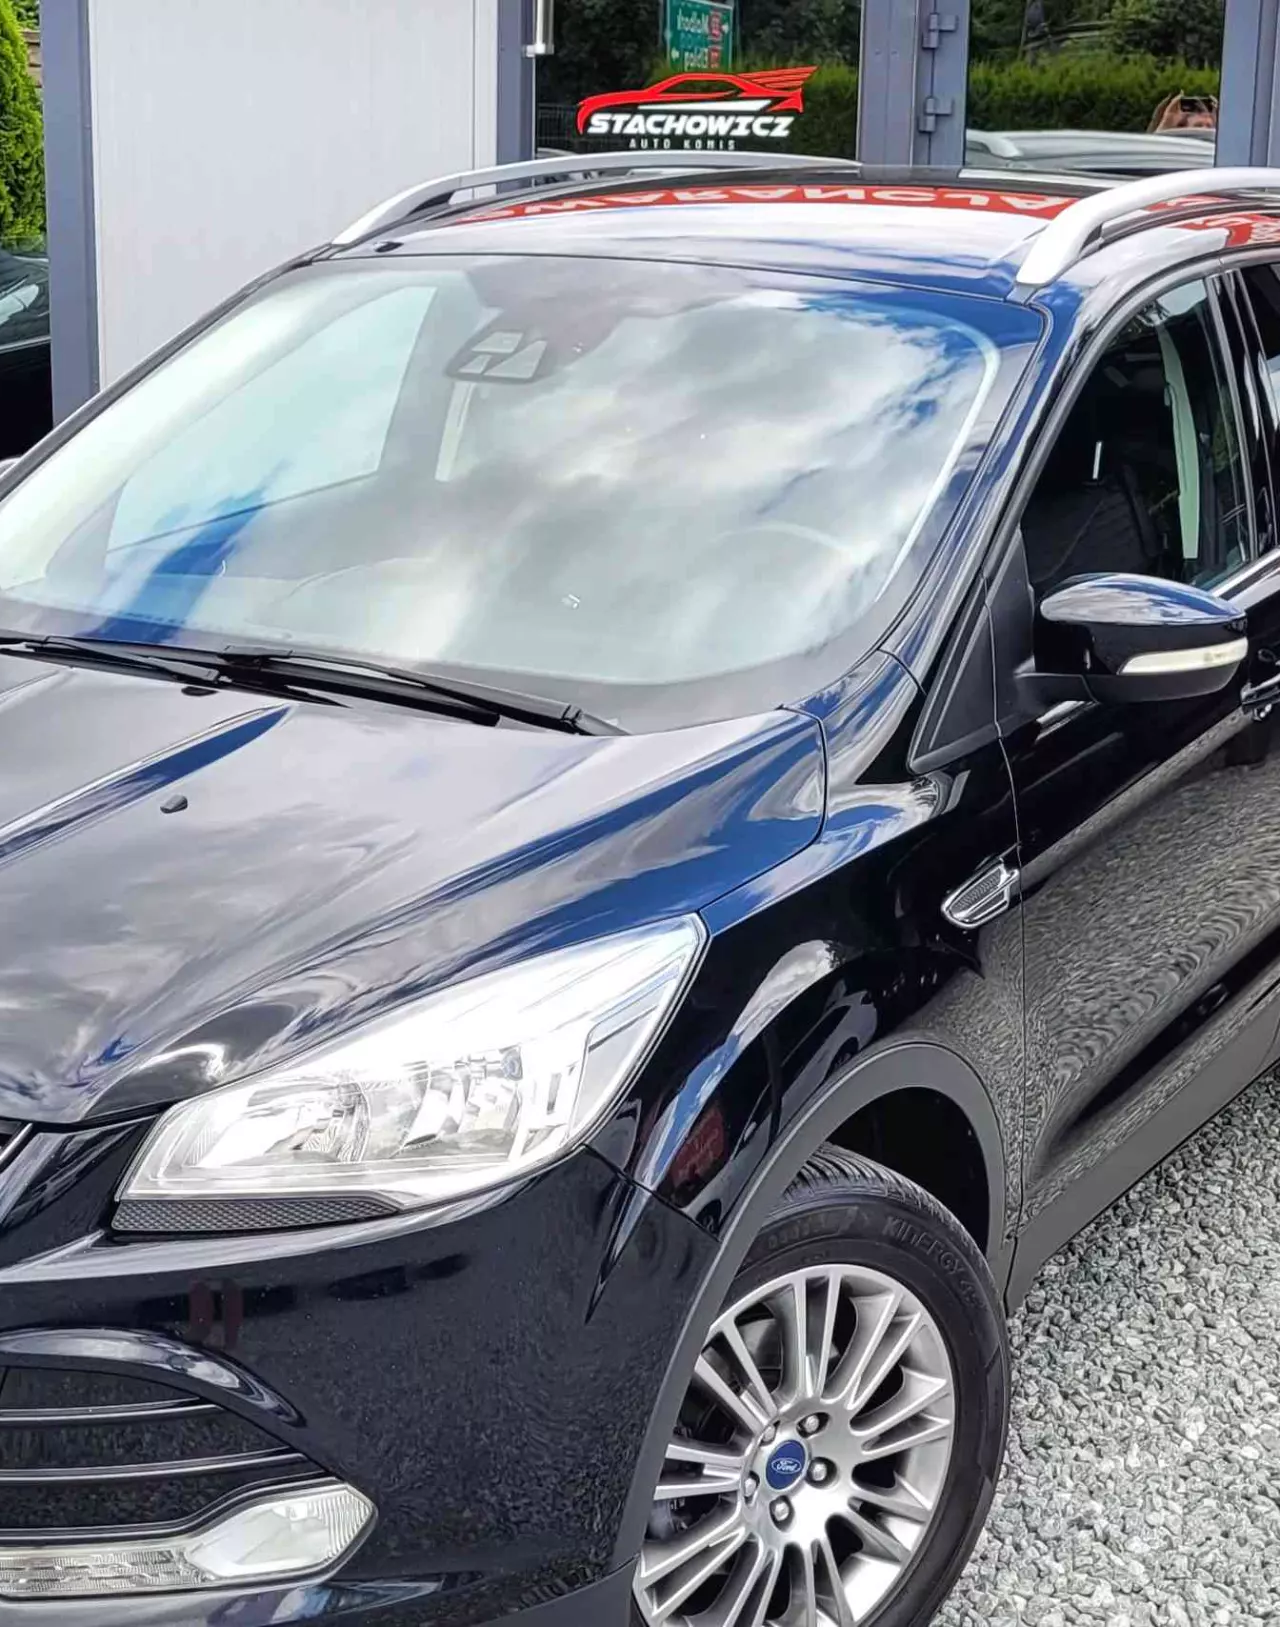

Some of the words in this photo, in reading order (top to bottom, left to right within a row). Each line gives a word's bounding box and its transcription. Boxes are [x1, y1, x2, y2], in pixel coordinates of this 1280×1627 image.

[586, 113, 795, 137] STACHOWICZ
[629, 138, 671, 149] AUTO
[683, 138, 736, 150] KOMIS
